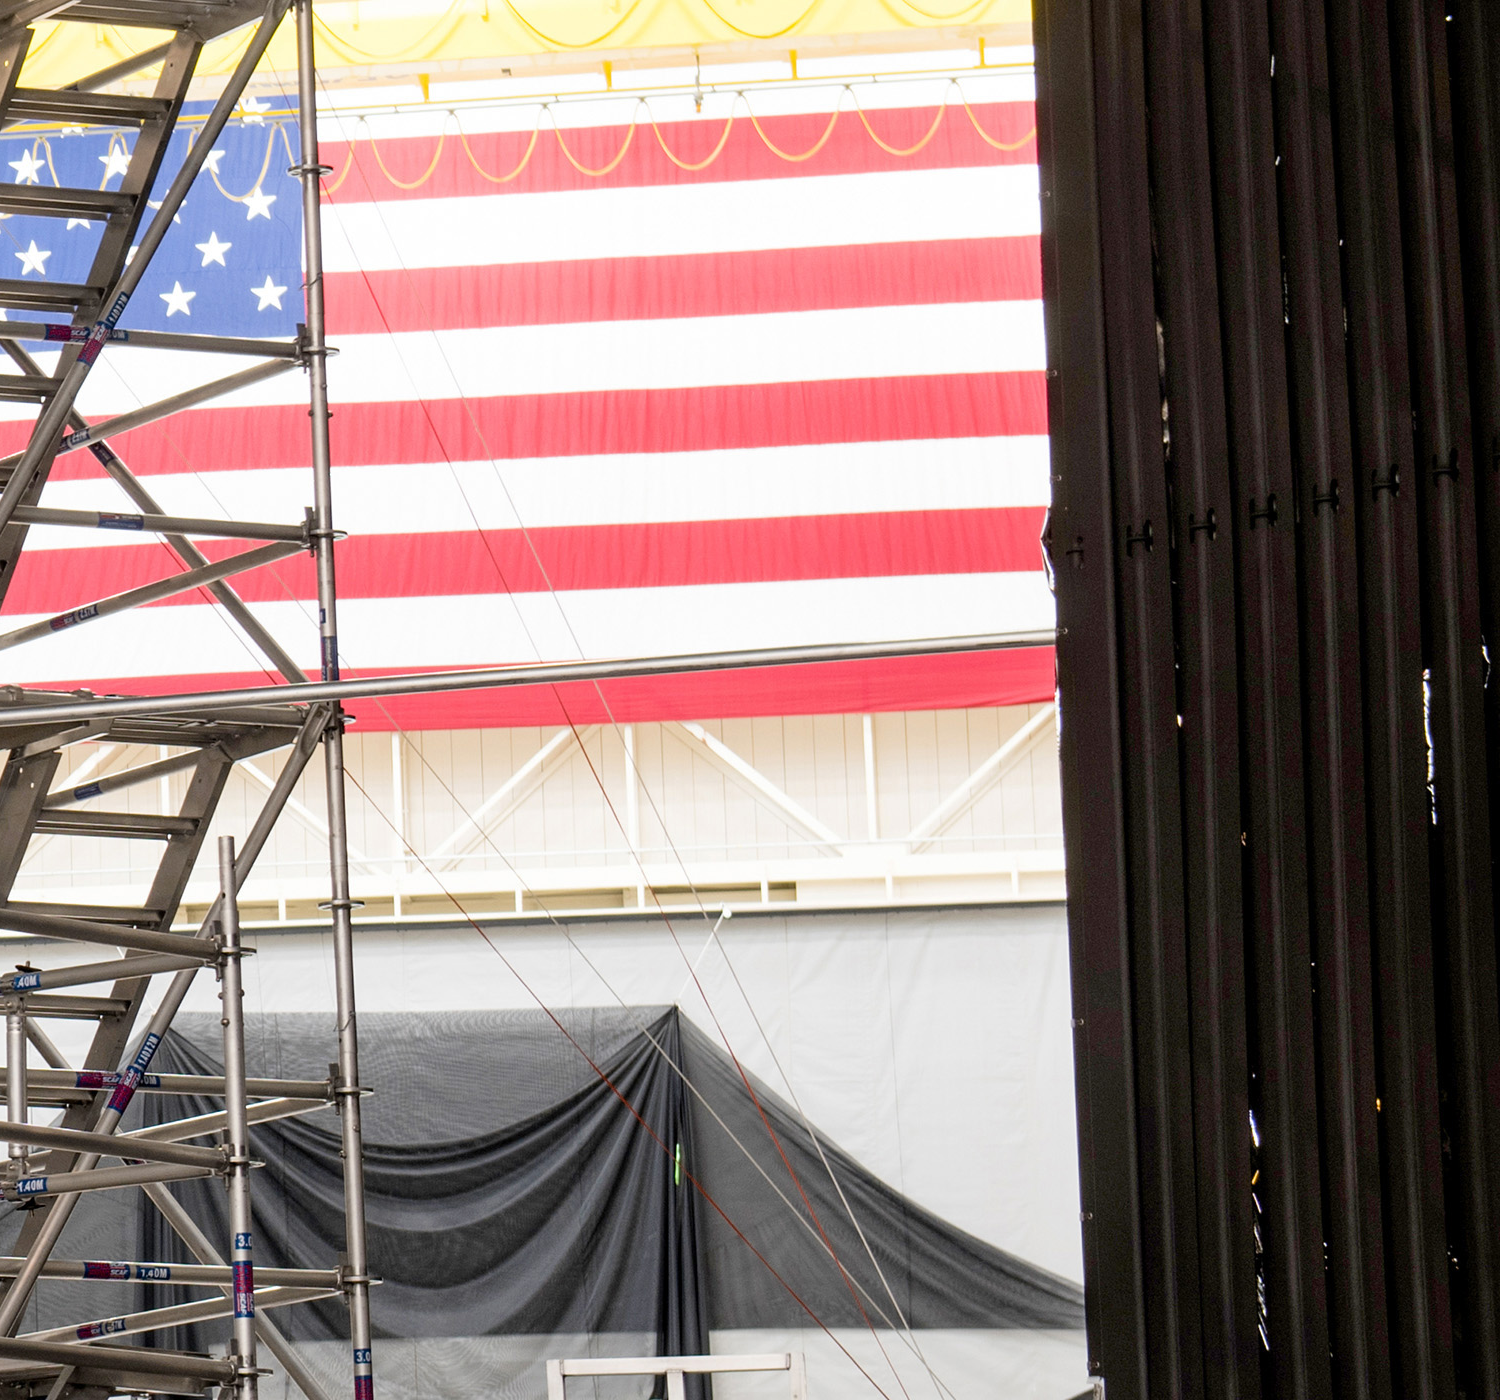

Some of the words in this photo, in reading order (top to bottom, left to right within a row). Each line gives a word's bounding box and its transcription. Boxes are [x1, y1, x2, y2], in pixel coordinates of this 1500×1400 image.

[14, 975, 41, 988] .40M
[17, 1179, 45, 1193] 1.40M
[238, 1235, 252, 1247] 3.0
[141, 1266, 168, 1279] 1.40M
[356, 1350, 371, 1362] 3.0
